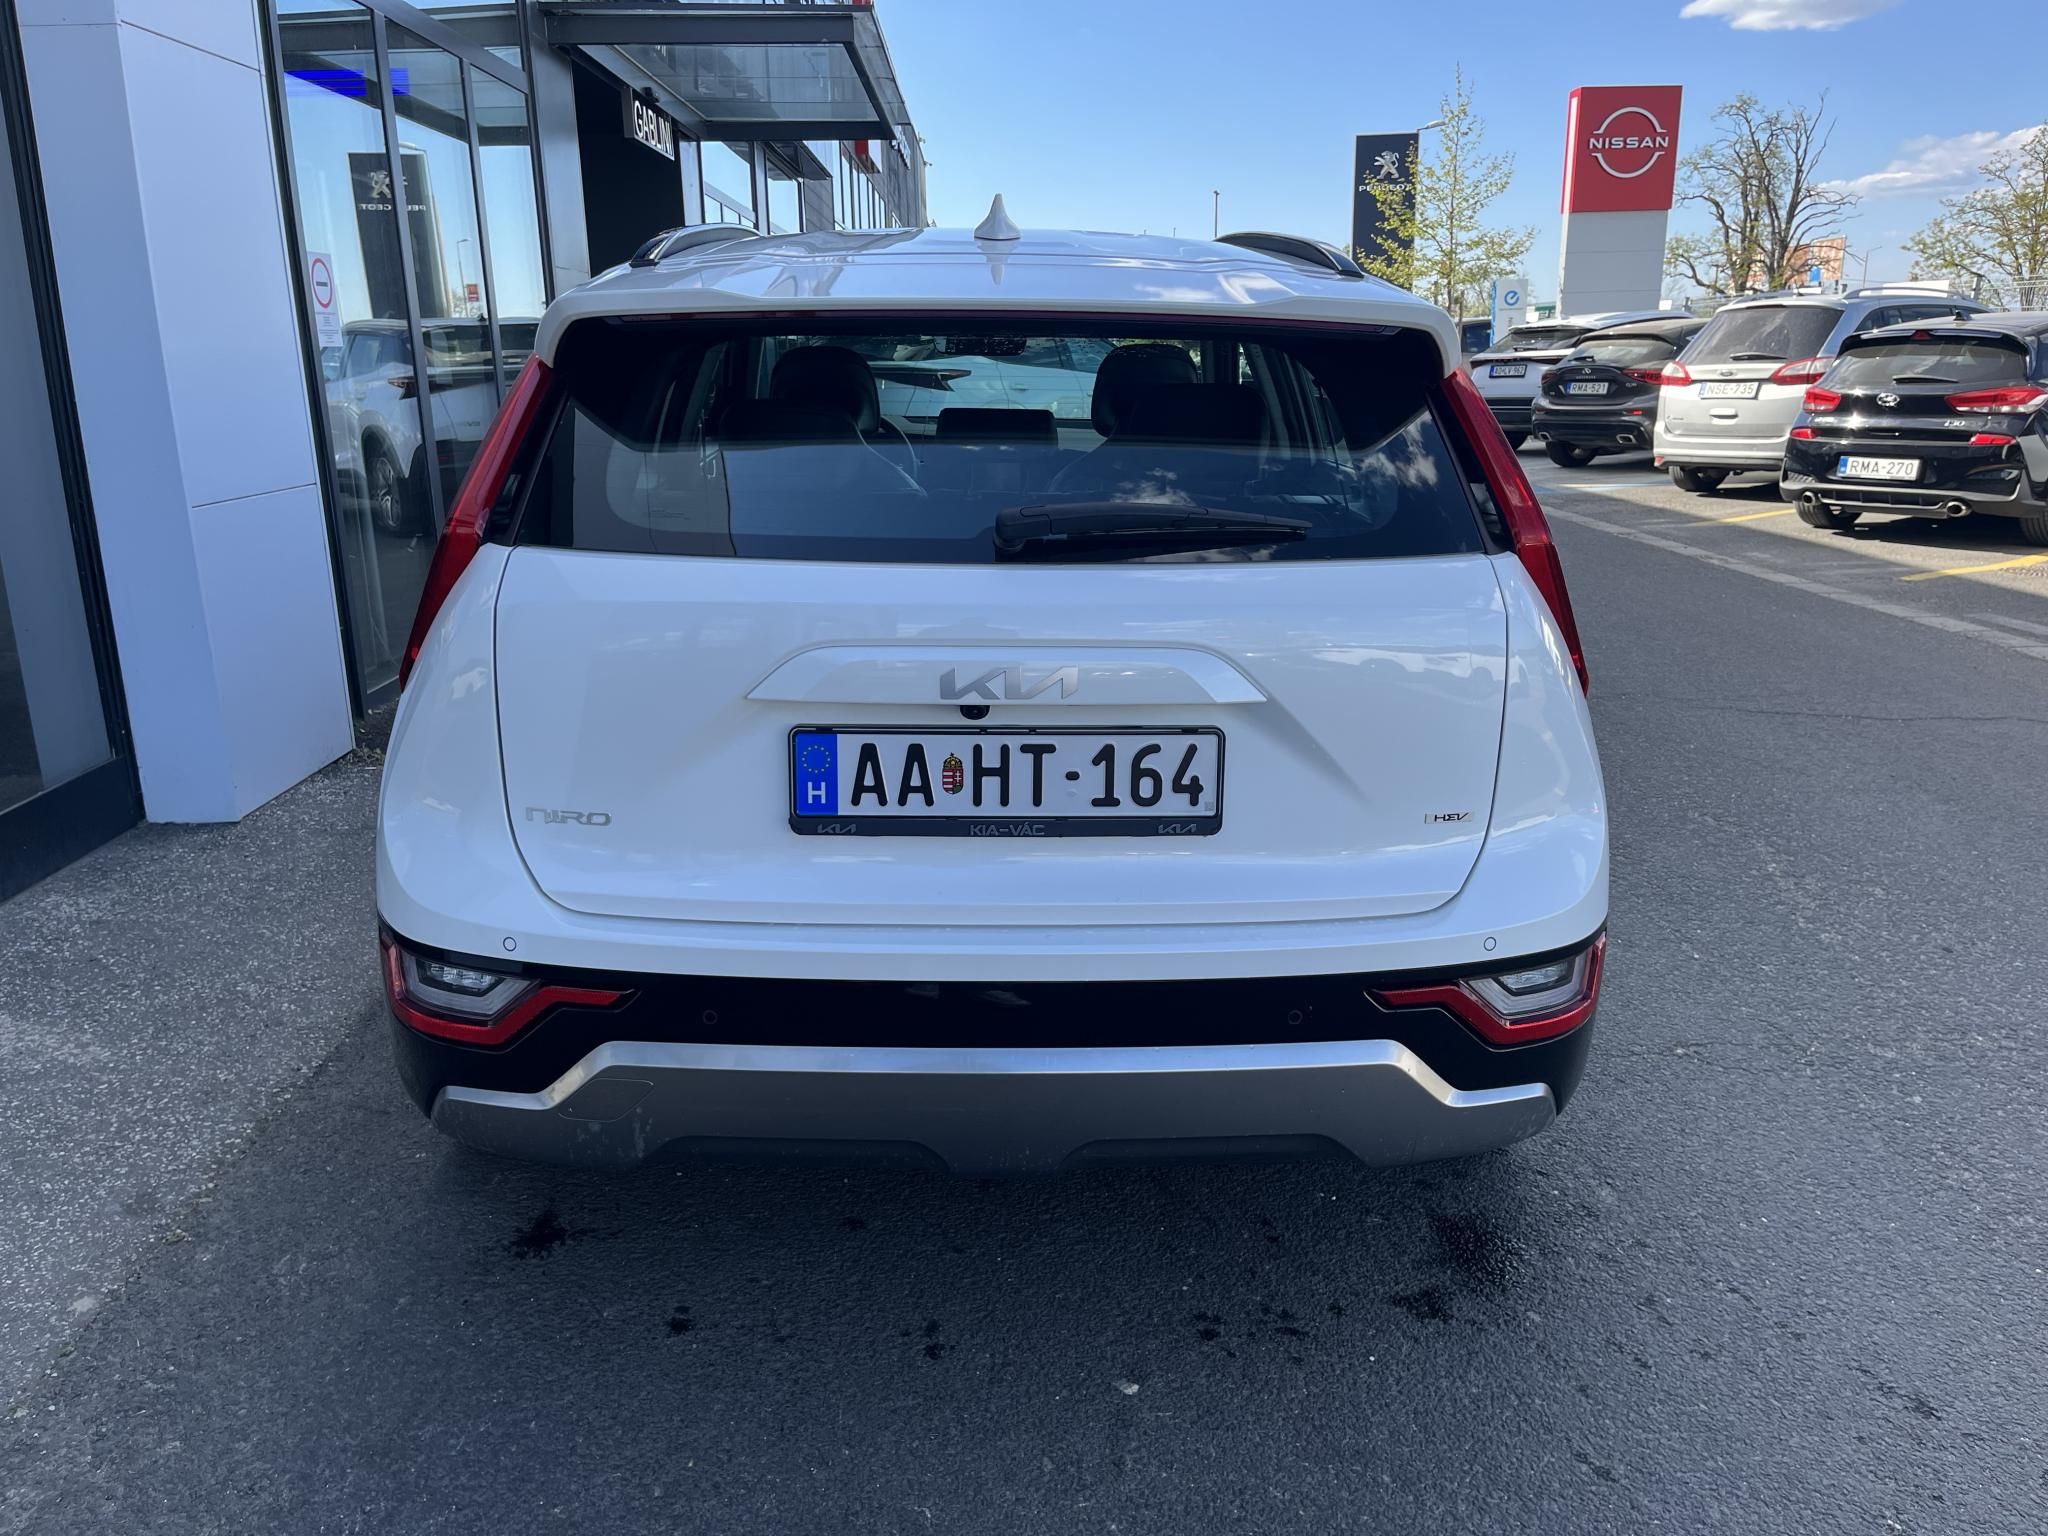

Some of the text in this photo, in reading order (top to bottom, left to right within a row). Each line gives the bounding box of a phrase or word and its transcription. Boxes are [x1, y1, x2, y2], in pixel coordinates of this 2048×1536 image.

[634, 100, 673, 156] GABLINI
[1589, 136, 1669, 149] NISSAN
[1572, 383, 1606, 393] RMA-521
[1707, 384, 1754, 394] NSE-735
[1850, 460, 1914, 475] RMA-270
[940, 665, 1079, 700] KIA
[851, 743, 1204, 807] AA HT-164
[807, 782, 826, 804] H
[525, 807, 612, 826] NIRO
[1434, 812, 1469, 822] HEV
[969, 822, 1045, 836] KIA-VÁC
